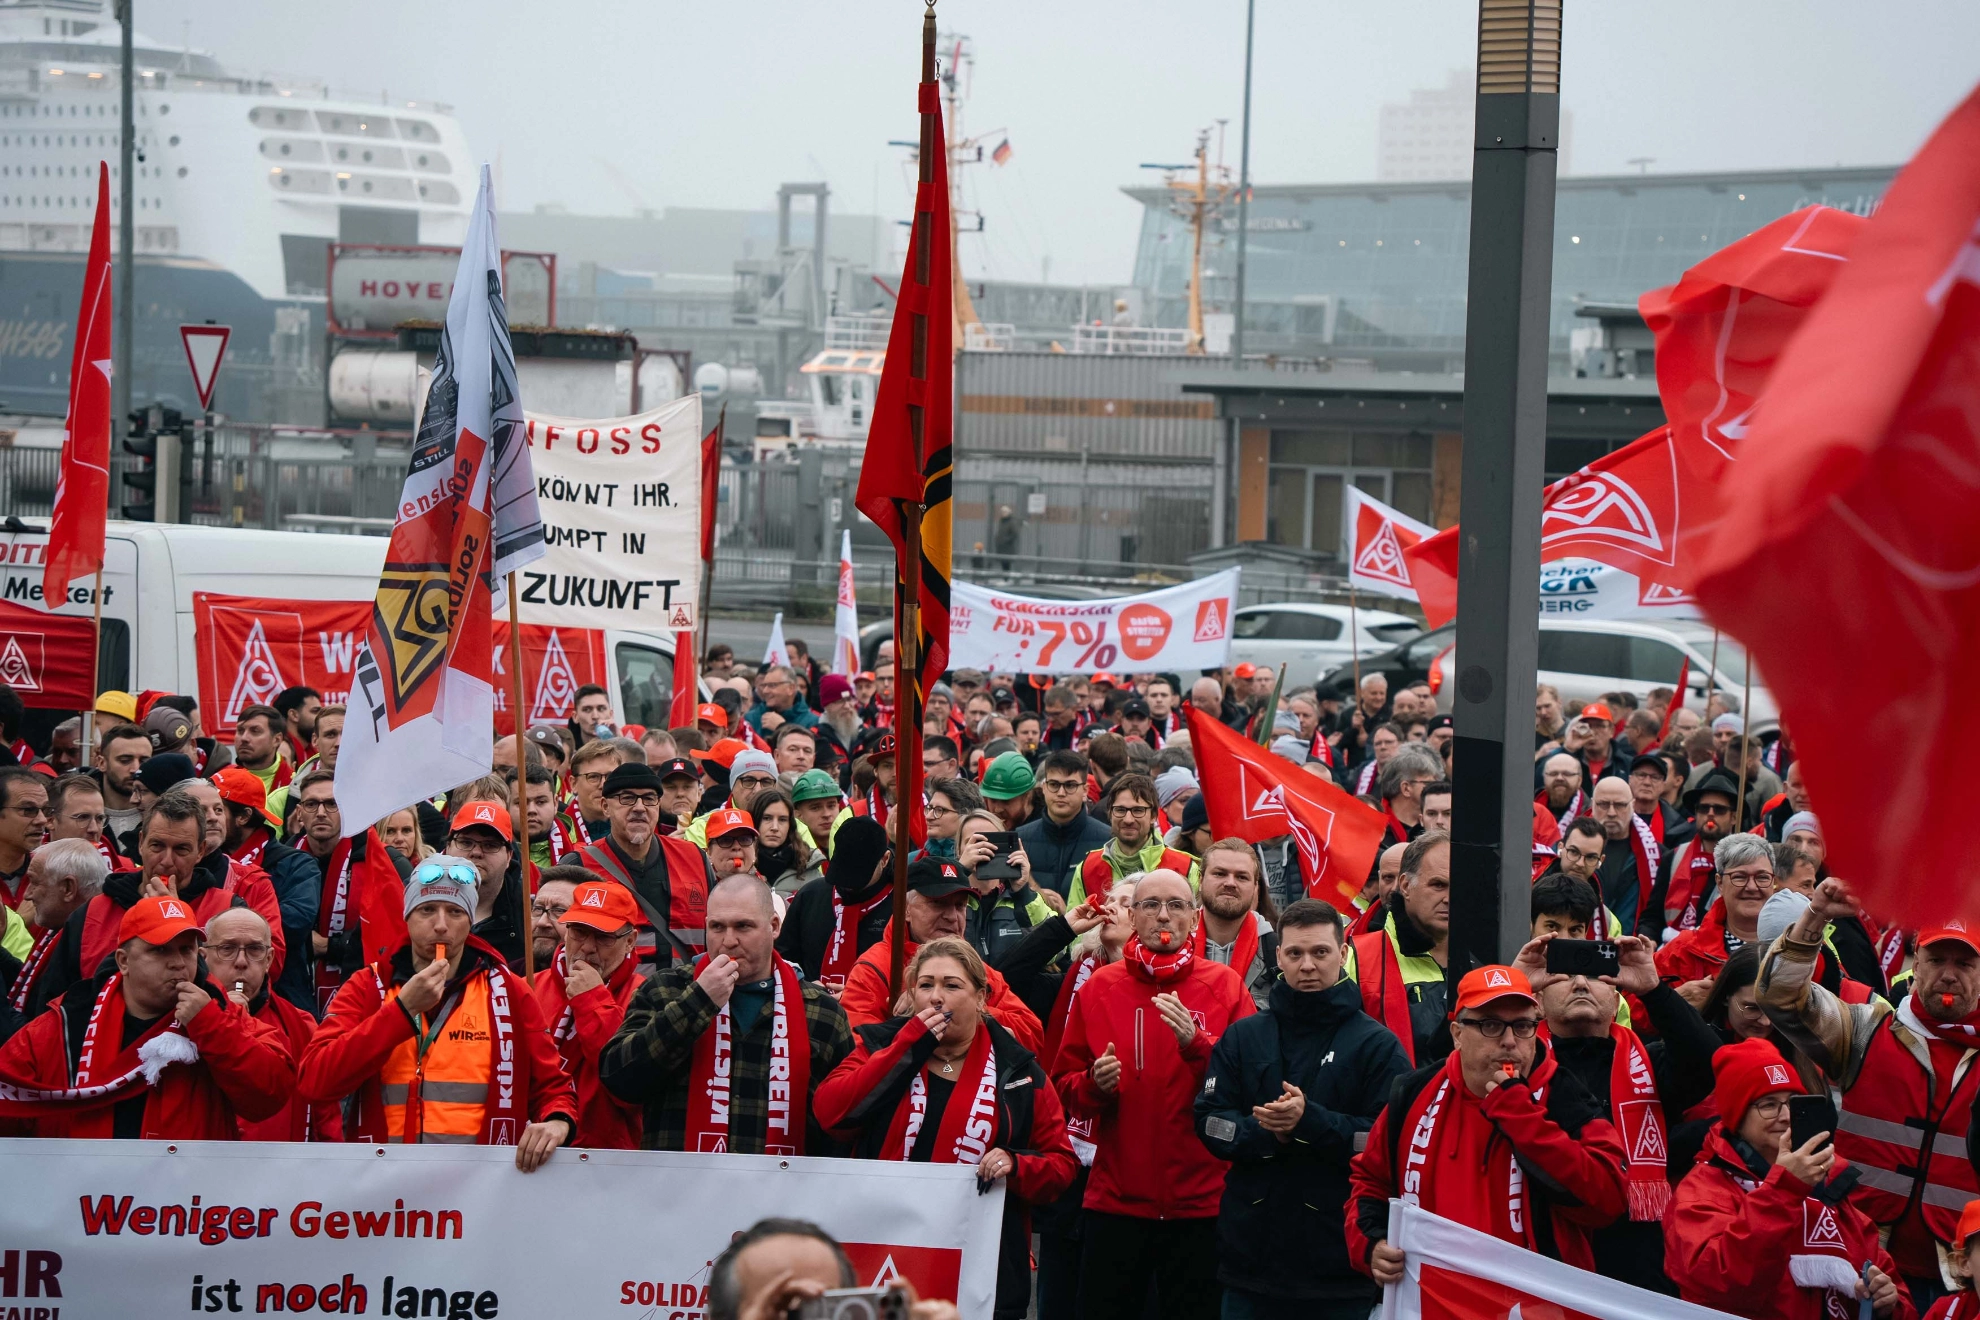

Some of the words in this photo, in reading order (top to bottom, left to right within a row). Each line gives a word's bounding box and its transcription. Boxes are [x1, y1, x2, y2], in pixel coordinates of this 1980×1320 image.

[361, 280, 454, 299] HOYE
[414, 447, 450, 468] STILL
[538, 475, 619, 507] KÖNNT
[633, 482, 678, 508] IHR,
[542, 523, 608, 552] UMPT
[623, 533, 646, 554] IN
[521, 571, 681, 611] ZUKUNFT
[993, 615, 1036, 637] FÜR
[1036, 620, 1118, 670] 7%
[449, 1030, 474, 1041] WIR
[80, 1194, 278, 1246] Weniger
[290, 1198, 464, 1240] Gewinn
[192, 1274, 243, 1313] ist
[256, 1273, 368, 1315] noch
[383, 1276, 500, 1320] lange
[620, 1280, 712, 1308] SOLIDA
